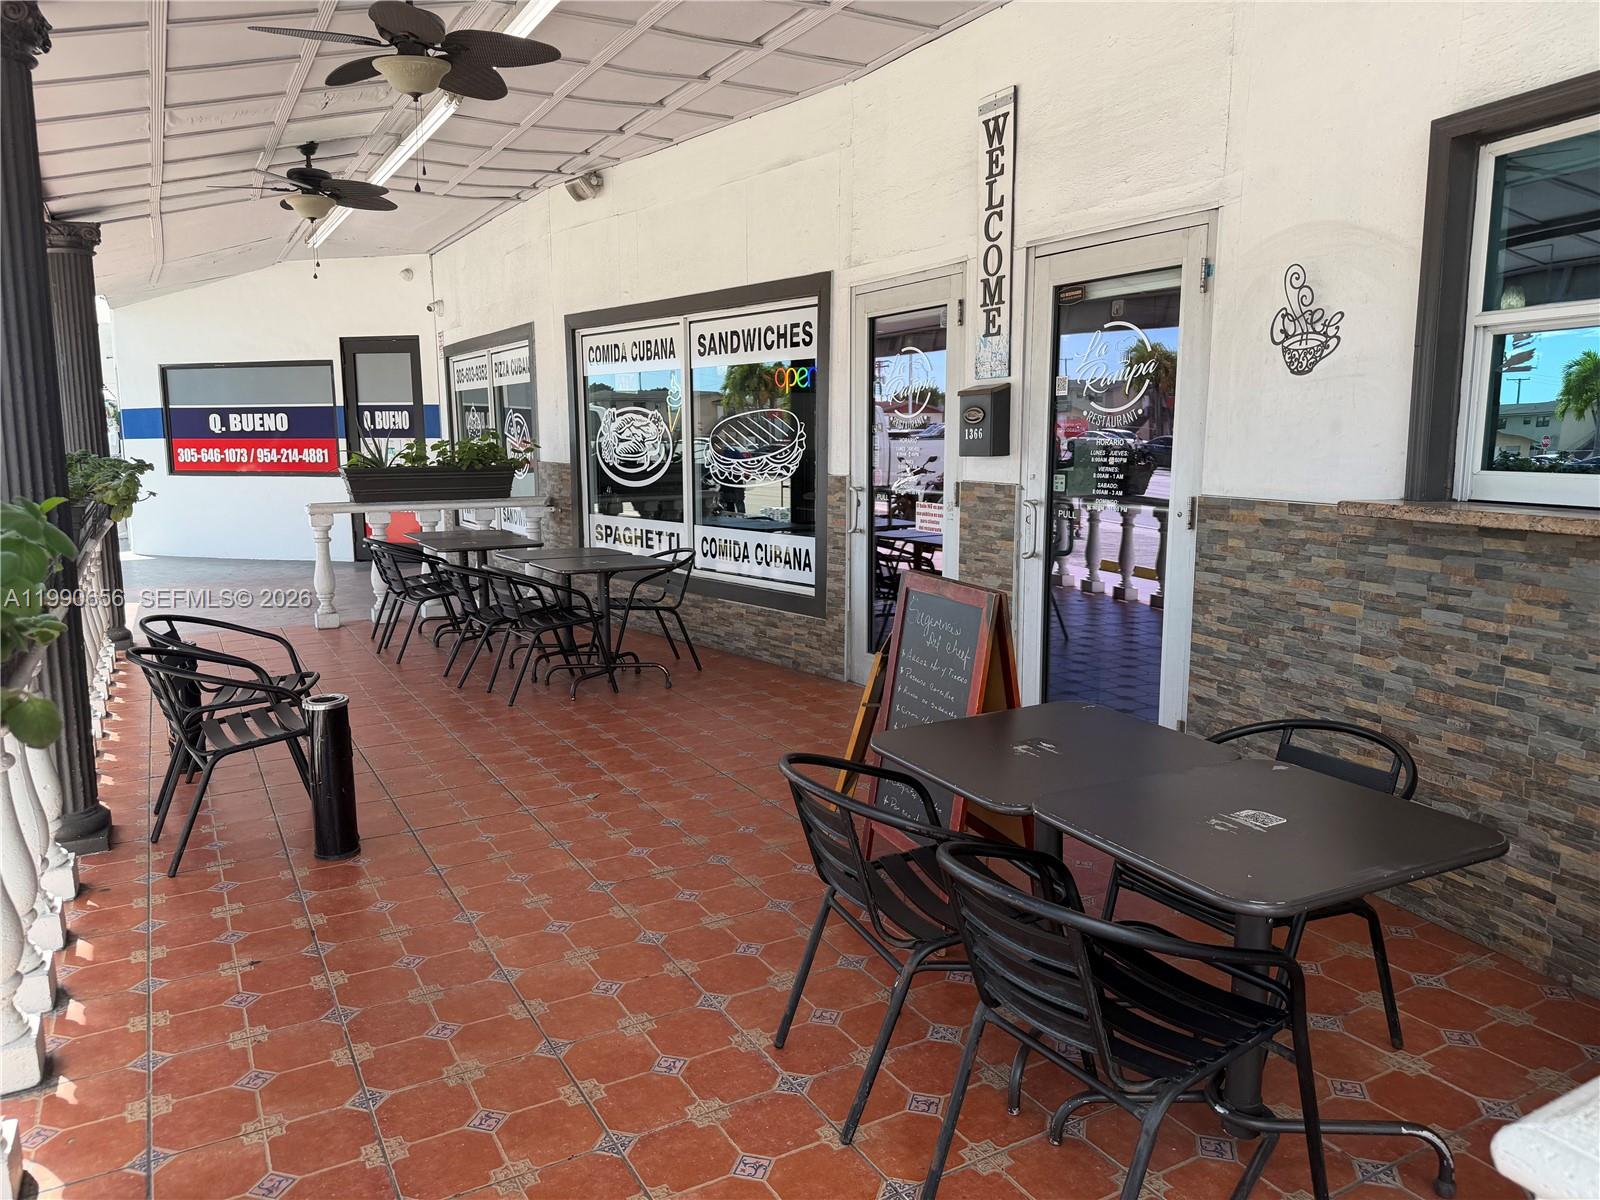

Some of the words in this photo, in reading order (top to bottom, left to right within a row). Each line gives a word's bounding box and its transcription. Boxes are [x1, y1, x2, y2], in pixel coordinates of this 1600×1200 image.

[981, 111, 1009, 338] WELCOME
[697, 321, 813, 357] SANDWICHES
[588, 342, 627, 365] COMIDA
[631, 337, 676, 362] CUBANA
[494, 360, 510, 379] PIZZA
[1075, 359, 1159, 395] Rampa
[209, 413, 226, 433] Q.
[229, 412, 288, 432] BUENO
[375, 410, 410, 430] BUENO
[1086, 409, 1138, 427] RESTAURANT
[965, 428, 983, 440] 1366
[177, 448, 248, 464] 305-646-1073
[256, 448, 329, 463] 954-214-4881
[1058, 510, 1077, 519] PULL
[595, 524, 680, 550] SPAGHETTI
[701, 536, 750, 563] COMIDA
[755, 543, 813, 573] CUBANA
